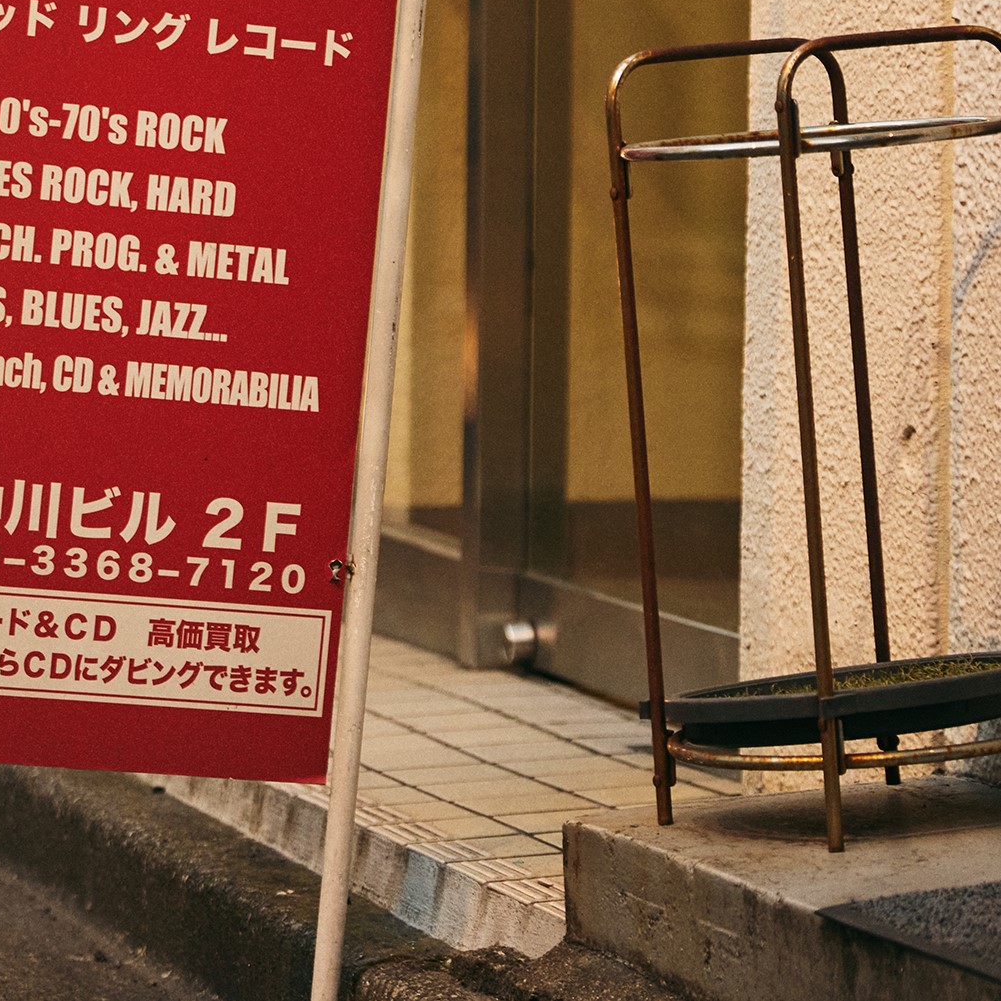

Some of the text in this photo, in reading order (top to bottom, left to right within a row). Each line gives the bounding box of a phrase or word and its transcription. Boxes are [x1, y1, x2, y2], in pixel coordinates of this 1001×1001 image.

[78, 4, 191, 51] リング
[206, 18, 354, 67] レコード
[134, 109, 228, 155] ROCK
[39, 163, 138, 213] ROCK,
[145, 173, 237, 217] HARD
[49, 227, 147, 273] PROG.
[154, 243, 180, 276] &
[186, 240, 290, 286] METAL
[20, 288, 129, 338] BLUES,
[135, 299, 228, 343] JAZZ...
[52, 354, 94, 394] CD
[97, 364, 120, 396] &
[124, 360, 320, 413] MEMORABILIA
[147, 617, 261, 654] 高価買取
